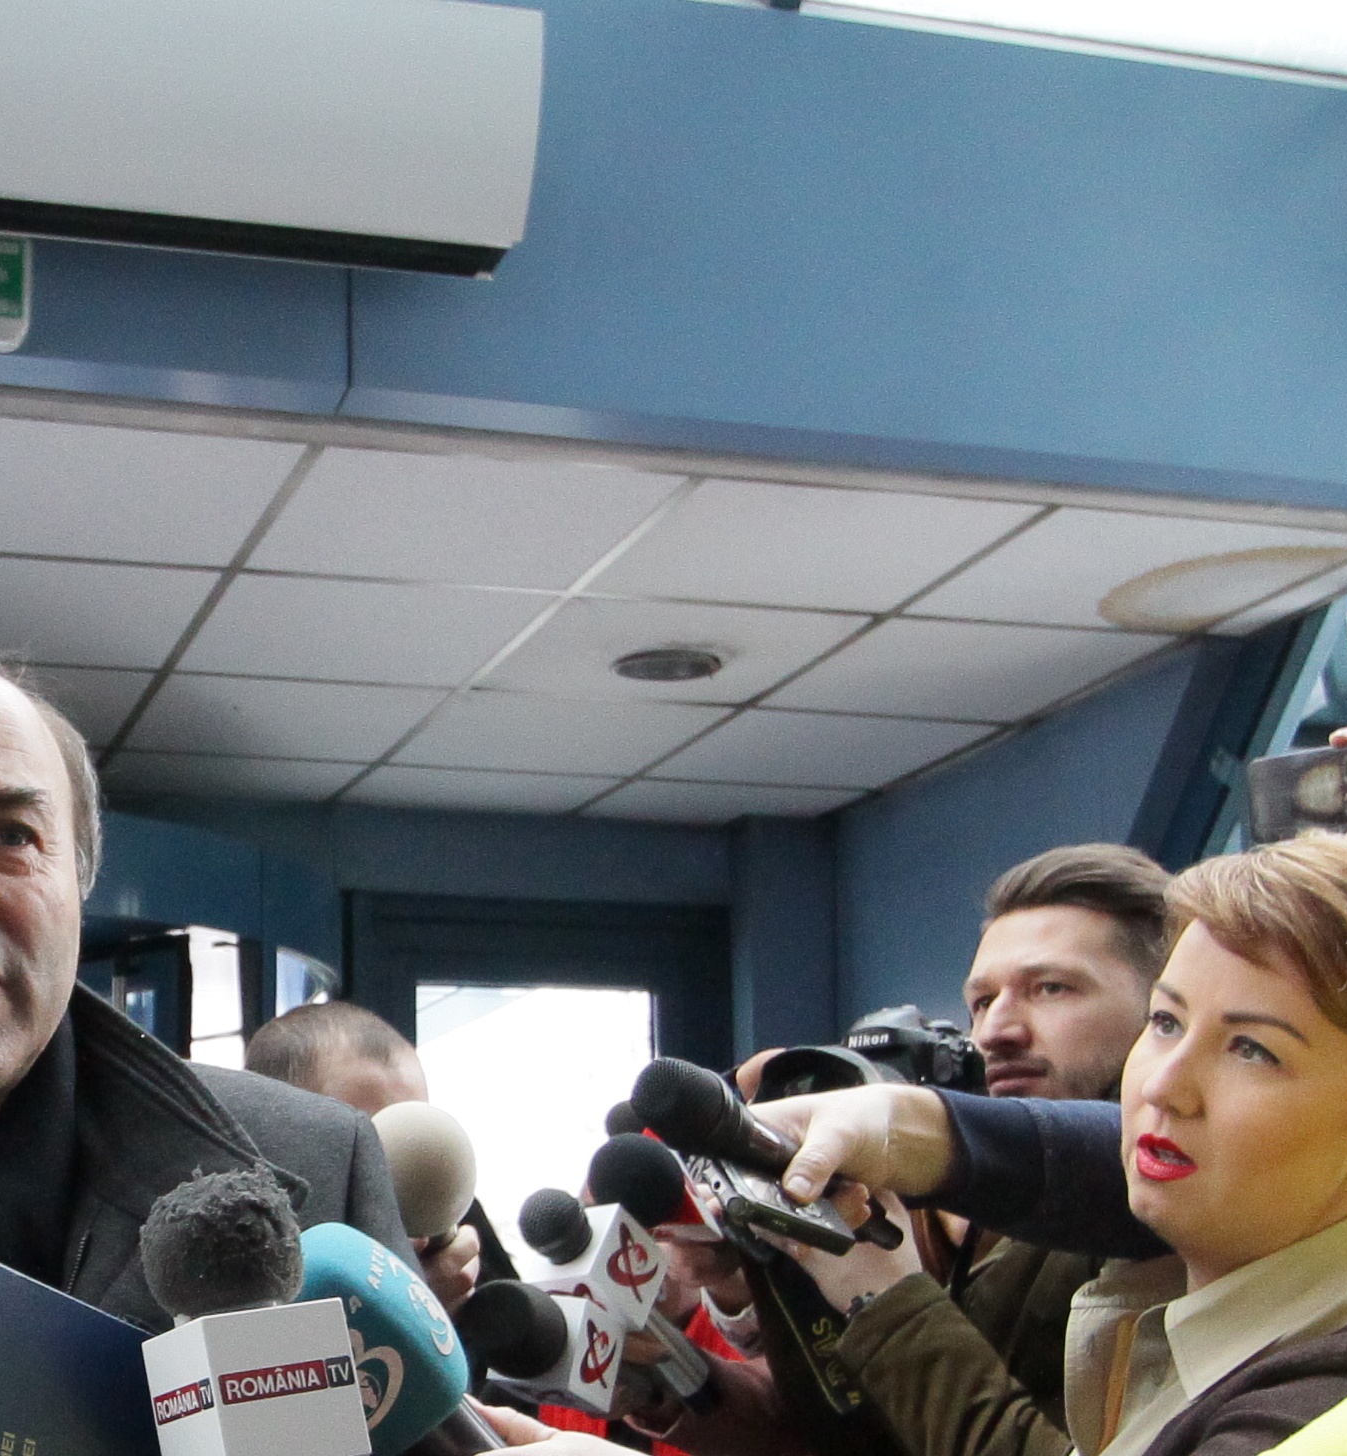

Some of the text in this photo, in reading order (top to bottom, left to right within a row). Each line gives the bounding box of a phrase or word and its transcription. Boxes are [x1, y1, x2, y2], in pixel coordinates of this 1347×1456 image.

[848, 1033, 889, 1049] Nikon
[226, 1362, 350, 1401] ROMÂNIA TV
[157, 1383, 213, 1422] ROMÂNIA TV
